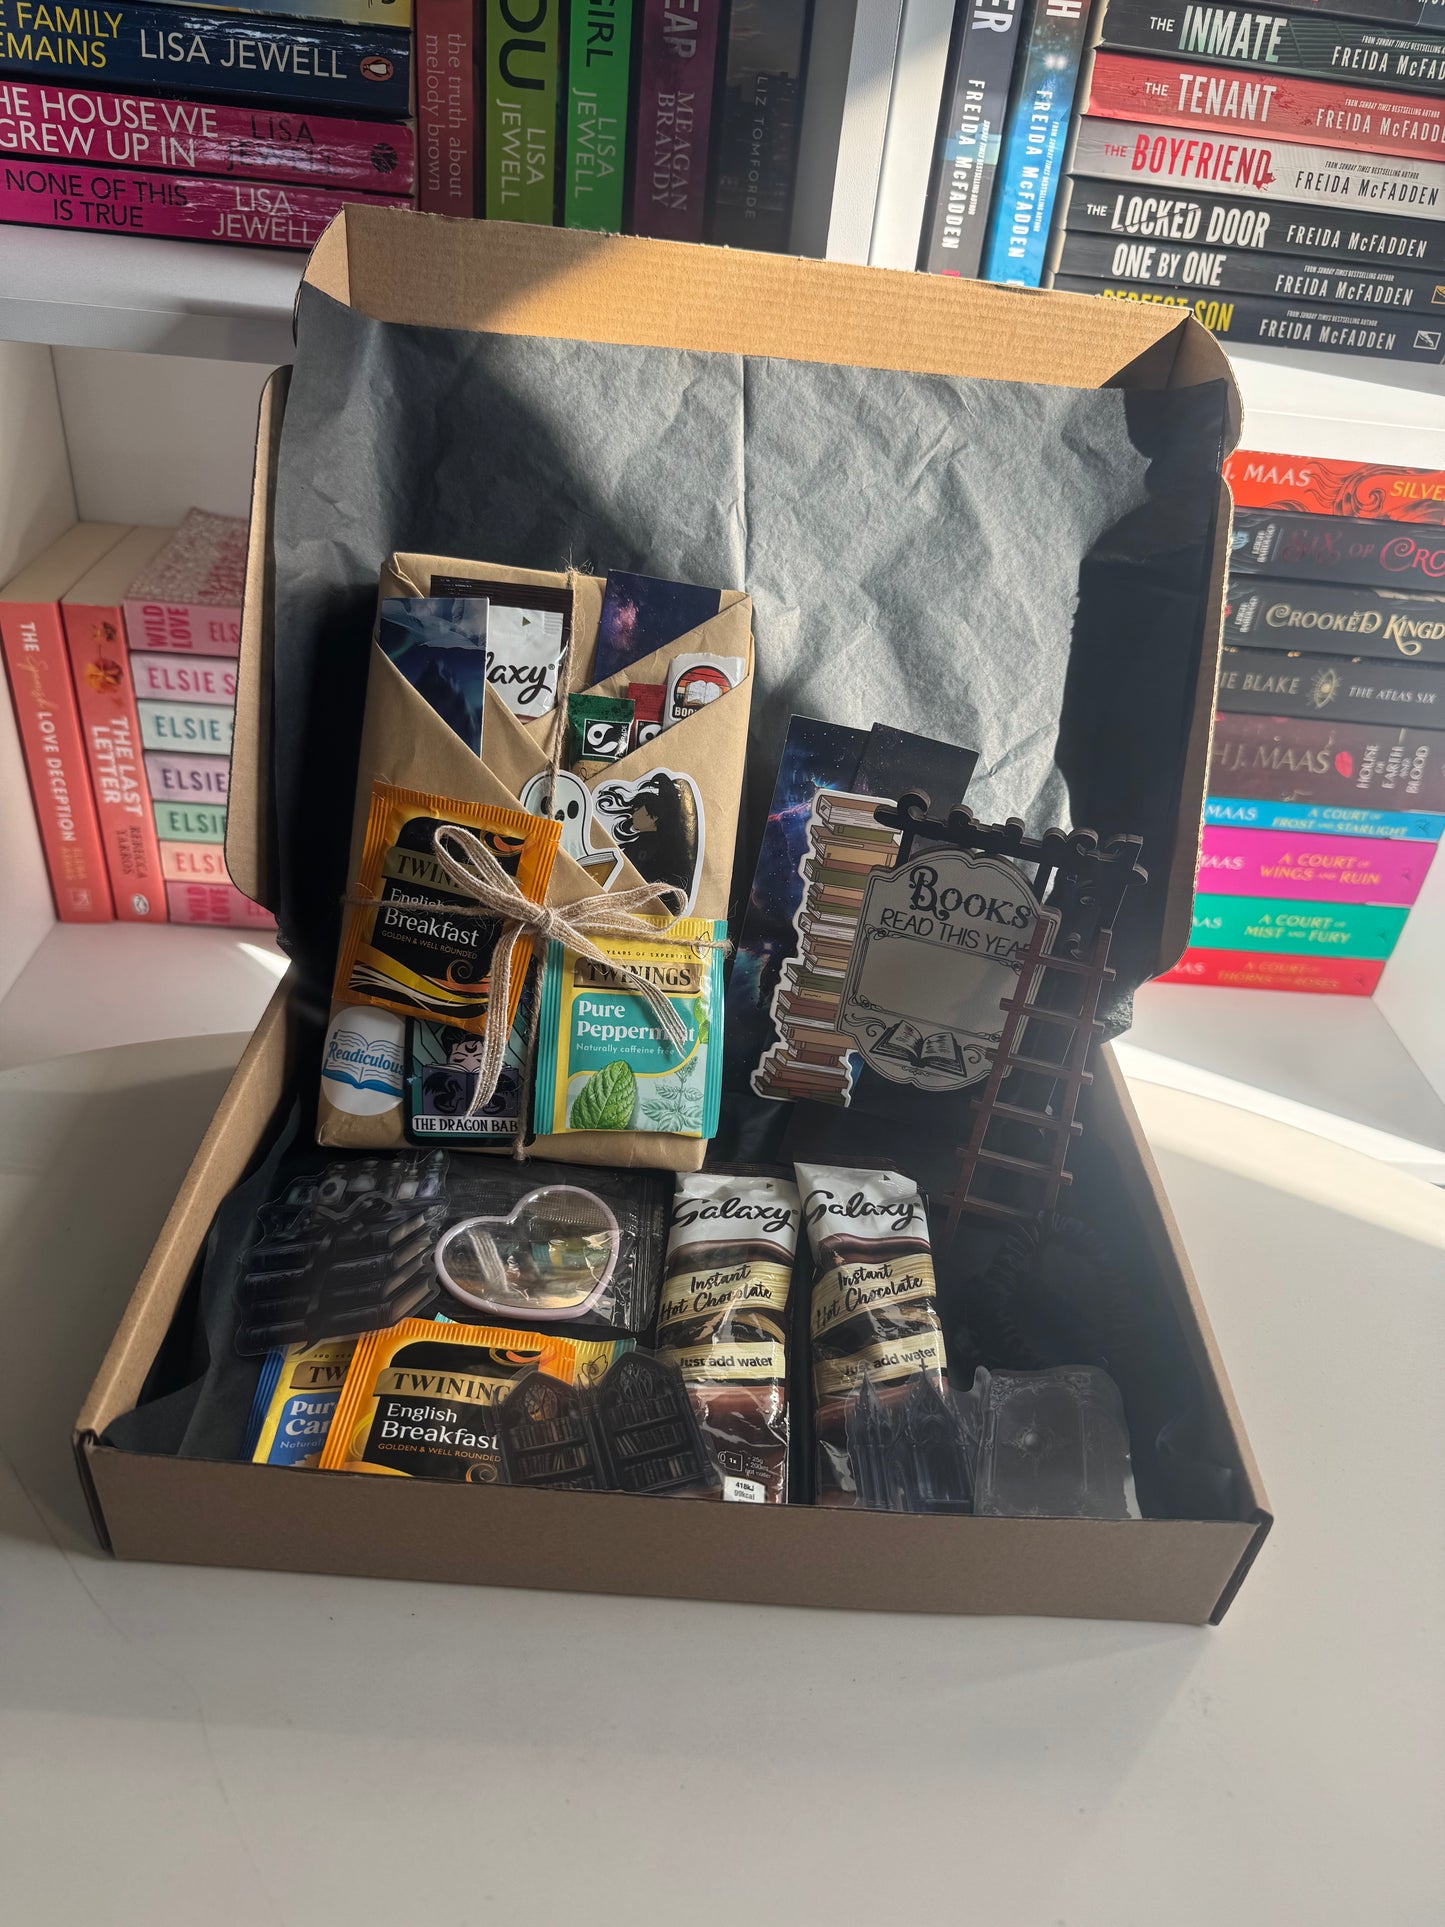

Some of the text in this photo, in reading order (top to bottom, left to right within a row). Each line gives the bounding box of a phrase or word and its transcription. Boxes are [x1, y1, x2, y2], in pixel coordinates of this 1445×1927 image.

[16, 1, 123, 39] FAMILY
[1150, 5, 1288, 63] THE INMATE
[140, 29, 348, 79] LISA JEWELL
[1331, 46, 1389, 73] FREIDA
[41, 89, 158, 132] HOUSE
[162, 103, 218, 138] WE
[421, 35, 446, 191] melody brown
[958, 79, 986, 146] FREIDA
[1145, 73, 1277, 123] THE TENANT
[1344, 98, 1441, 118] FROM SUNDAY TIMES BESTSELLING AUTHOR
[251, 115, 315, 144] LISA
[448, 33, 468, 198] the truth about
[1026, 89, 1053, 156] FREIDA
[1316, 108, 1371, 134] FREIDA
[0, 118, 195, 168] GREW UP IN
[496, 98, 522, 205] JEWELL
[527, 128, 546, 185] LISA
[573, 87, 597, 199] JEWELL
[597, 117, 617, 178] LISA
[652, 92, 675, 207] BRANDY
[670, 91, 695, 211] MEAGAN
[745, 75, 768, 220] LIZ TOMFORDE
[1104, 133, 1274, 188] THE BOYFRIEND
[1325, 160, 1420, 180] FROM SUNDAY TIMES BESTSELLING AUTHOR
[5, 168, 189, 207] NONE OF THIS
[236, 187, 293, 216] LISA
[942, 156, 973, 249] McFADDEN
[1295, 170, 1439, 206] FREIDA McFADDEN
[53, 198, 144, 227] IS TRUE
[212, 213, 316, 245] JEWELL
[1008, 166, 1040, 258] McFADDEN
[1086, 194, 1271, 248] THE LOCKED DOOR
[1286, 224, 1428, 258] FREIDA McFADDEN
[1111, 242, 1227, 287] ONE BY ONE
[1274, 274, 1414, 306] FREIDA McFADDEN
[1195, 299, 1235, 333] SON
[1259, 318, 1396, 351] FREIDA McFADDEN
[1243, 463, 1312, 488] MAAS
[142, 605, 169, 648] WILD
[168, 607, 193, 649] LOVE
[1265, 602, 1382, 634] CROOKED
[19, 621, 41, 653] THE
[148, 666, 216, 694] ELSIE
[1242, 672, 1301, 695] BLAKE
[1349, 686, 1372, 699] THE
[37, 712, 60, 753] LOVE
[154, 714, 222, 741] ELSIE
[91, 725, 122, 804] LETTER
[111, 716, 144, 817] THE LAST
[1252, 745, 1331, 774] MAAS
[162, 767, 227, 793] ELSIE
[46, 757, 77, 842] DECEPTION
[1205, 805, 1258, 821] MAAS
[1307, 808, 1368, 821] A COURT
[1260, 865, 1380, 885] WINGS RUIN
[1278, 852, 1358, 869] A COURT
[384, 907, 480, 948] Breakfast
[880, 907, 934, 937] READ
[940, 921, 980, 949] THIS
[1243, 925, 1351, 945] MIST FURY
[1257, 913, 1333, 929] A COURT
[381, 930, 478, 960] GOLDEN WELL ROUNDED
[606, 949, 632, 957] YEARS
[650, 952, 692, 960] EXPERTISE
[578, 1000, 626, 1018] Pure
[328, 1041, 405, 1076] Readiculous
[576, 1043, 675, 1055] Naturally caffeine free
[414, 1117, 436, 1131] THE
[439, 1118, 488, 1132] DRAGON
[671, 1197, 797, 1233] Galaxy
[803, 1189, 927, 1232] Galaxy
[690, 1264, 752, 1294] Instant
[837, 1263, 893, 1291] Instant
[658, 1281, 772, 1322] Hot Chocolate
[816, 1275, 924, 1329] Hot Chocolate
[708, 1355, 736, 1368] add
[739, 1356, 774, 1368] water
[873, 1346, 937, 1370] add water
[387, 1402, 458, 1423] English
[378, 1442, 502, 1463] GOLDEN WELL ROUNDED
[381, 1420, 499, 1451] Breakfast
